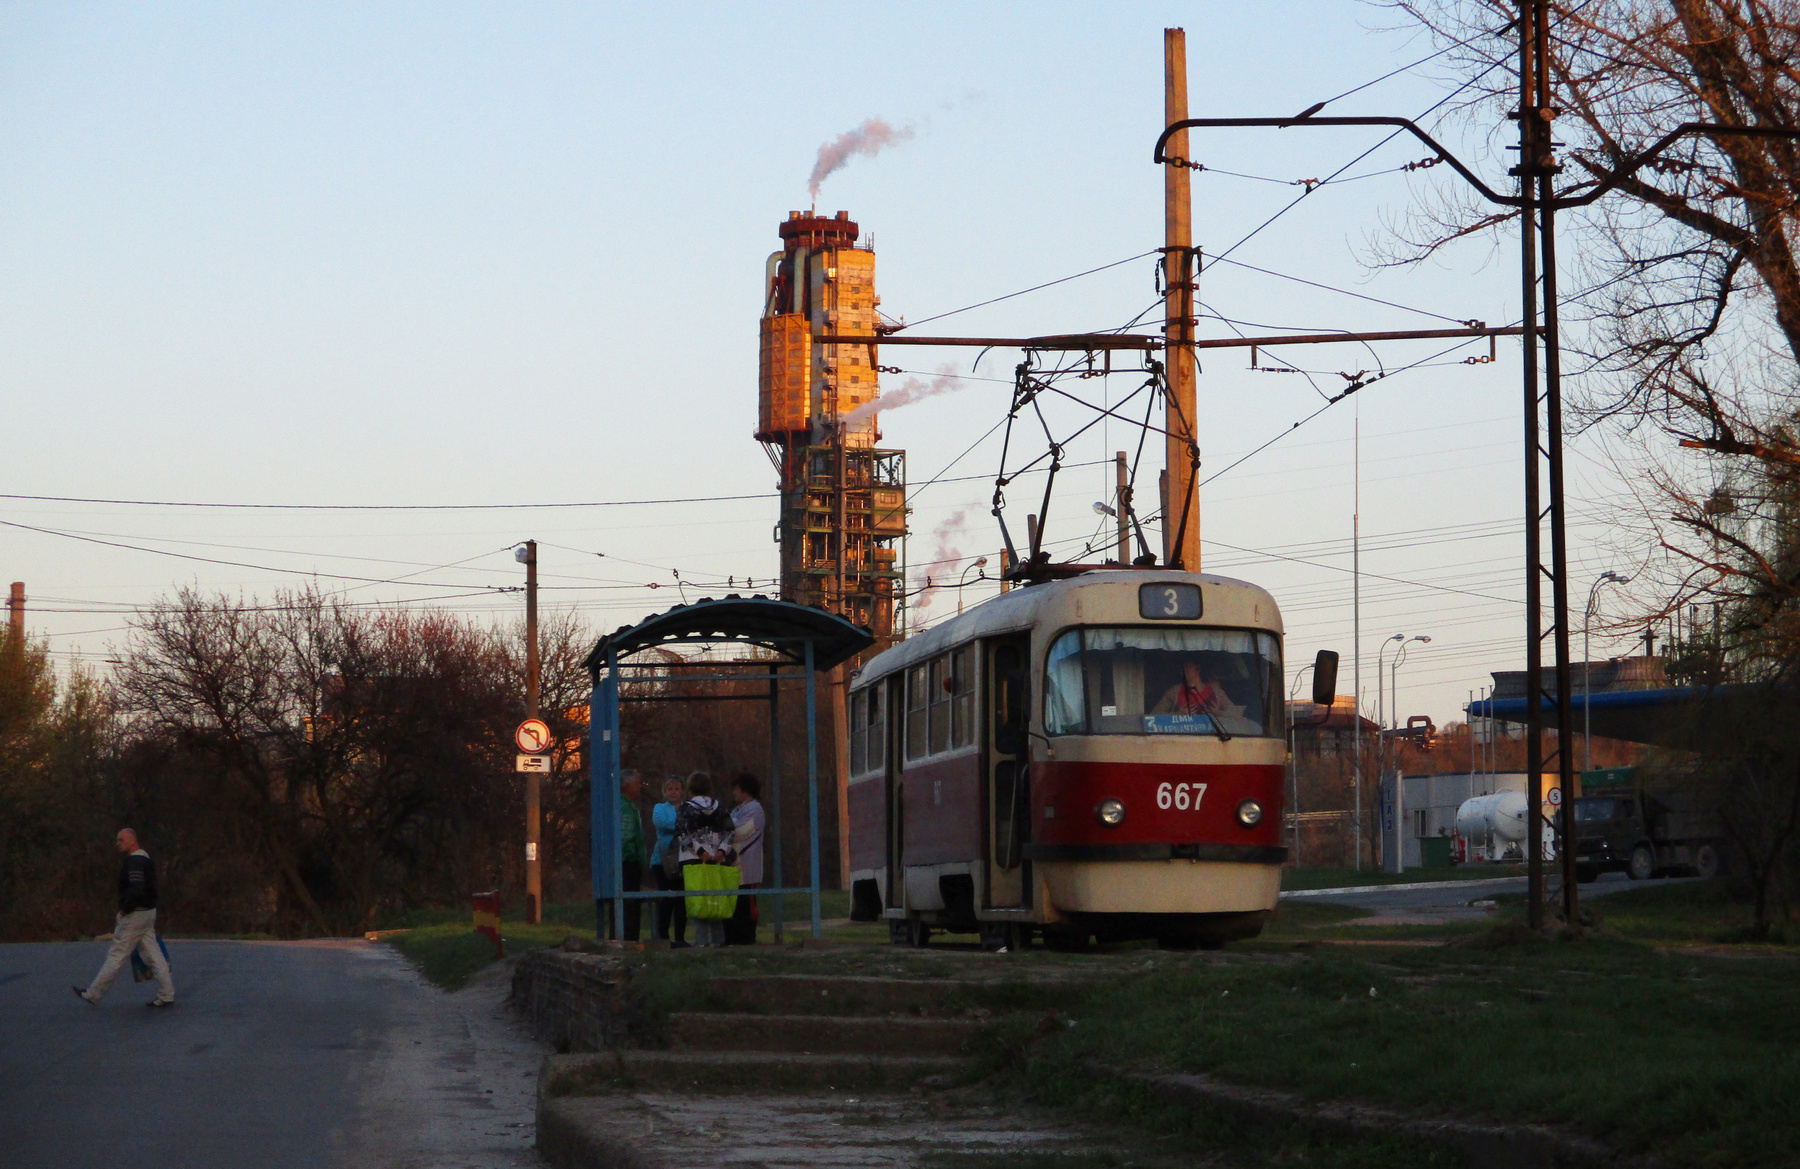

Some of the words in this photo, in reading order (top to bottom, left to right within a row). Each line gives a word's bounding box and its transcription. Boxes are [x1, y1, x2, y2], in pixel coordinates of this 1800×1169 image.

[1163, 588, 1179, 616] 3
[1156, 781, 1208, 811] 667
[1553, 792, 1559, 801] 5
